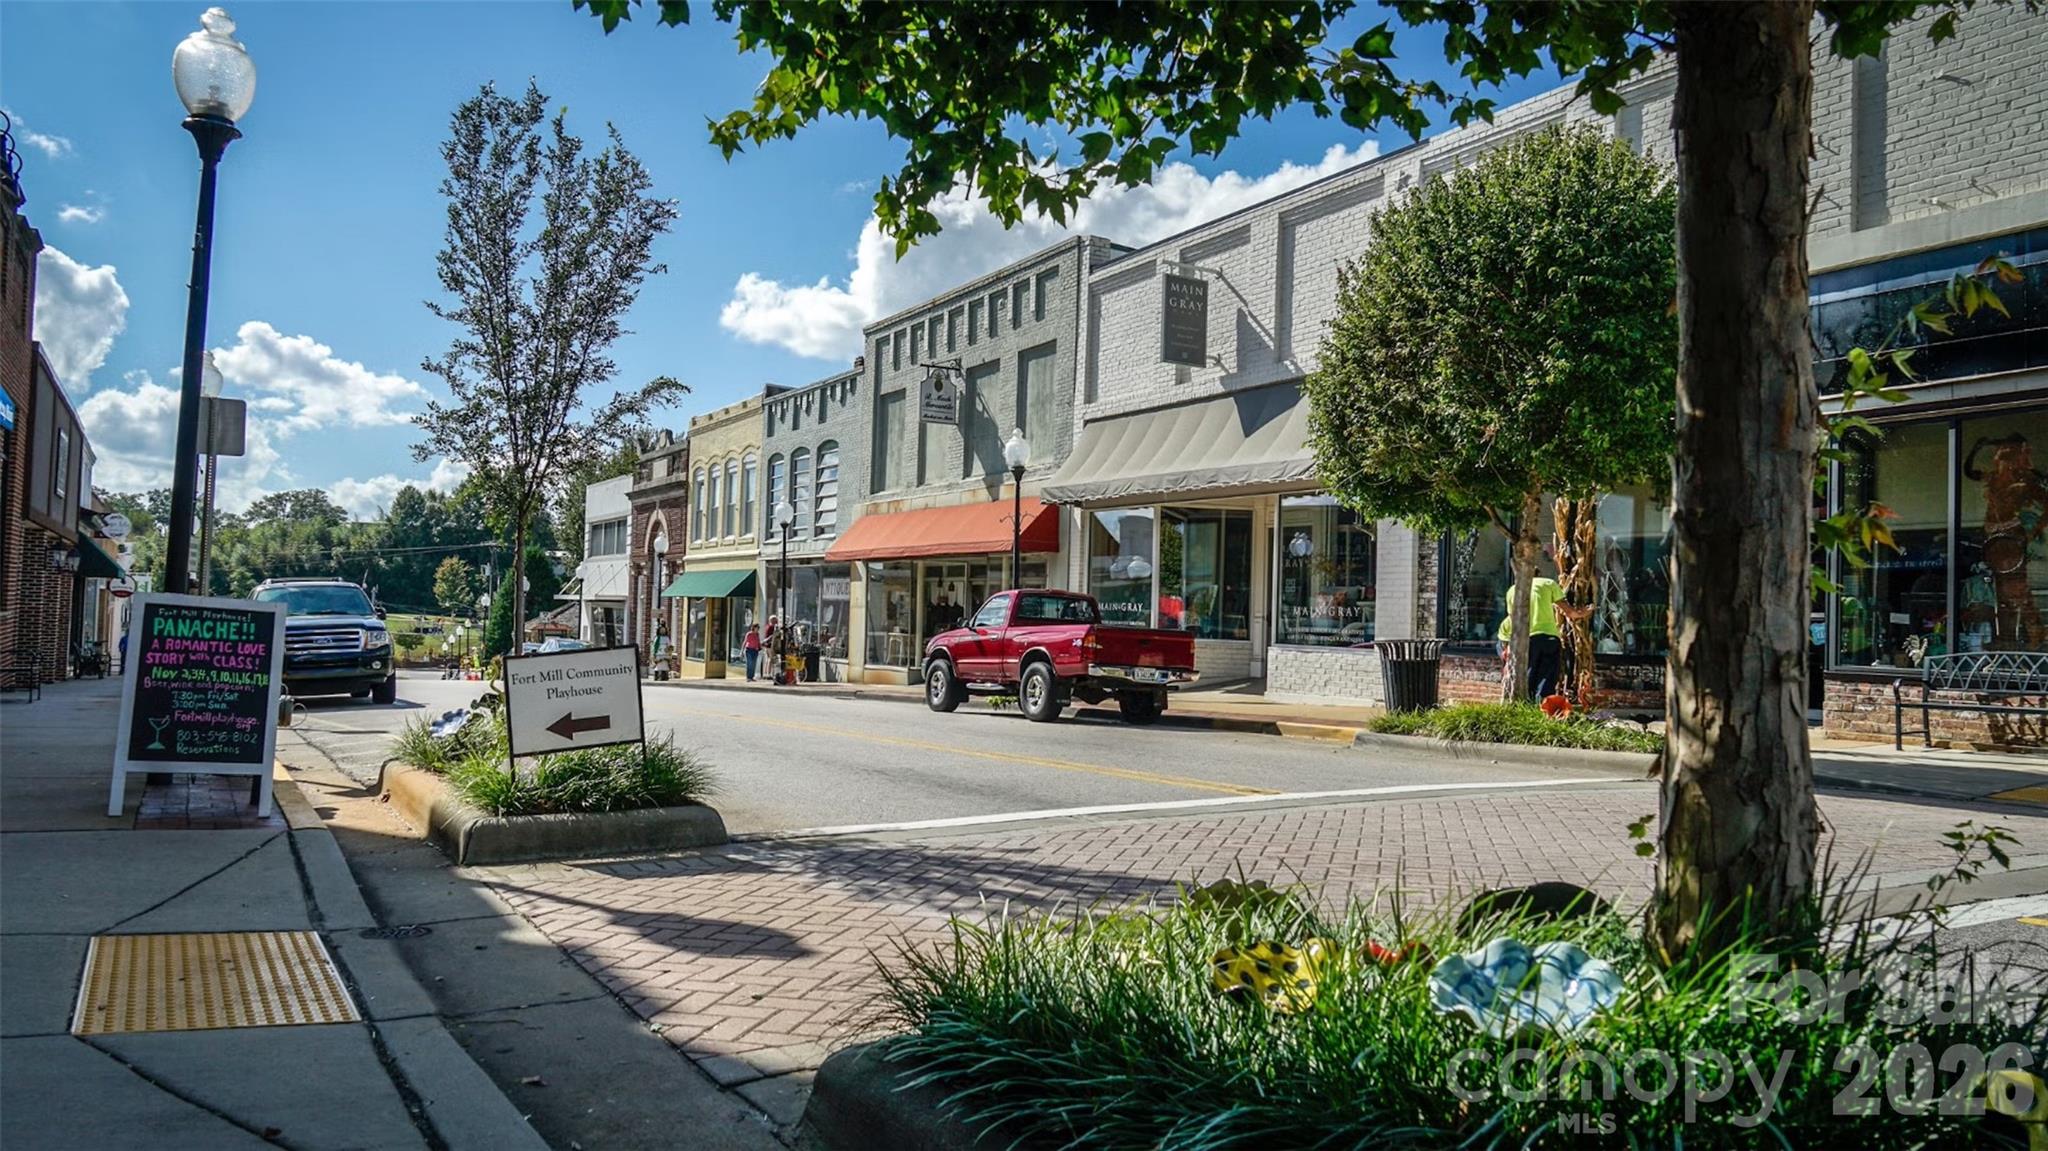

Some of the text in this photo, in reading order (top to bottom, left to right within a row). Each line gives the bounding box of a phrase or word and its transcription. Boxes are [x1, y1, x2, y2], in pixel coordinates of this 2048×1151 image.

[1170, 283, 1204, 296] MAIN
[1169, 297, 1204, 311] GRAY
[153, 616, 256, 640] PANACHE!!
[151, 637, 267, 656] A ROMANTIC LOVE
[145, 651, 260, 670] STORY with CLASS!
[151, 666, 178, 680] Nov
[511, 664, 633, 685] Fort Mill Community
[196, 681, 212, 689] and
[546, 686, 603, 700] Playhouse
[176, 742, 240, 755] Reservations
